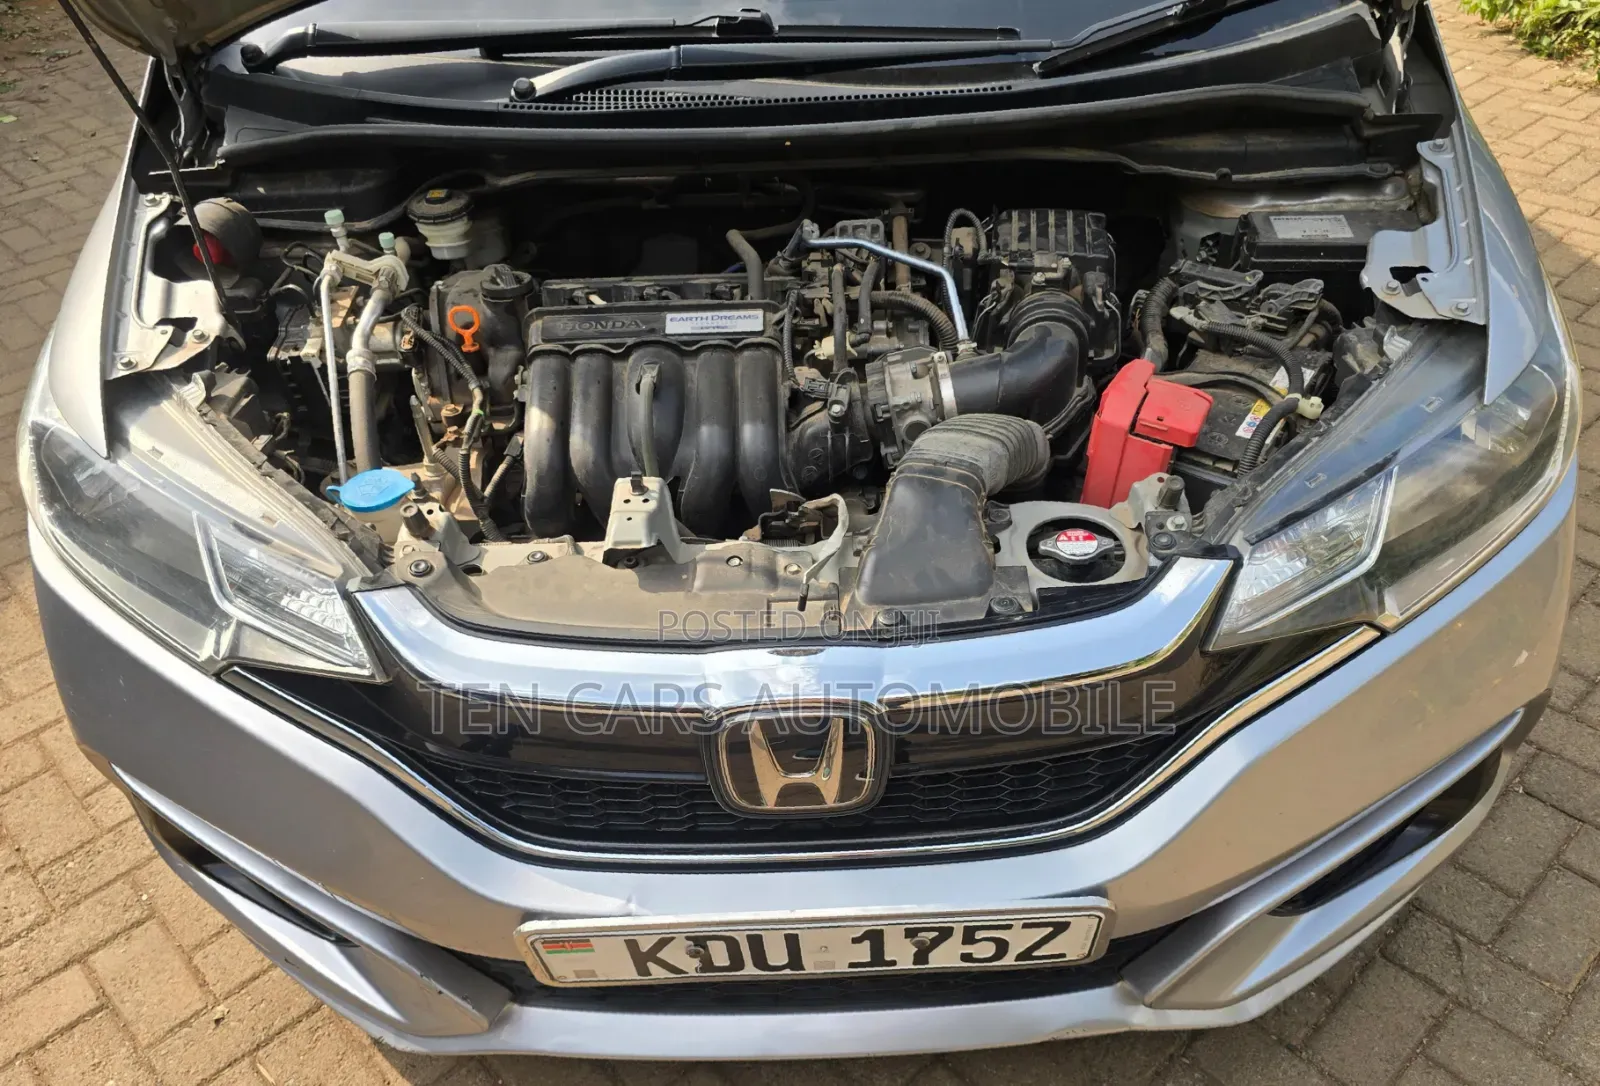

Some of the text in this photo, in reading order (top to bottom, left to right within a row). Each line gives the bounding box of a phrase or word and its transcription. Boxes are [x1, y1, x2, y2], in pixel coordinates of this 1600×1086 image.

[559, 318, 641, 332] HONDA
[669, 315, 709, 323] EARTH
[711, 313, 759, 321] DREAMS
[624, 933, 806, 977] KDU
[847, 920, 1072, 969] 175Z
